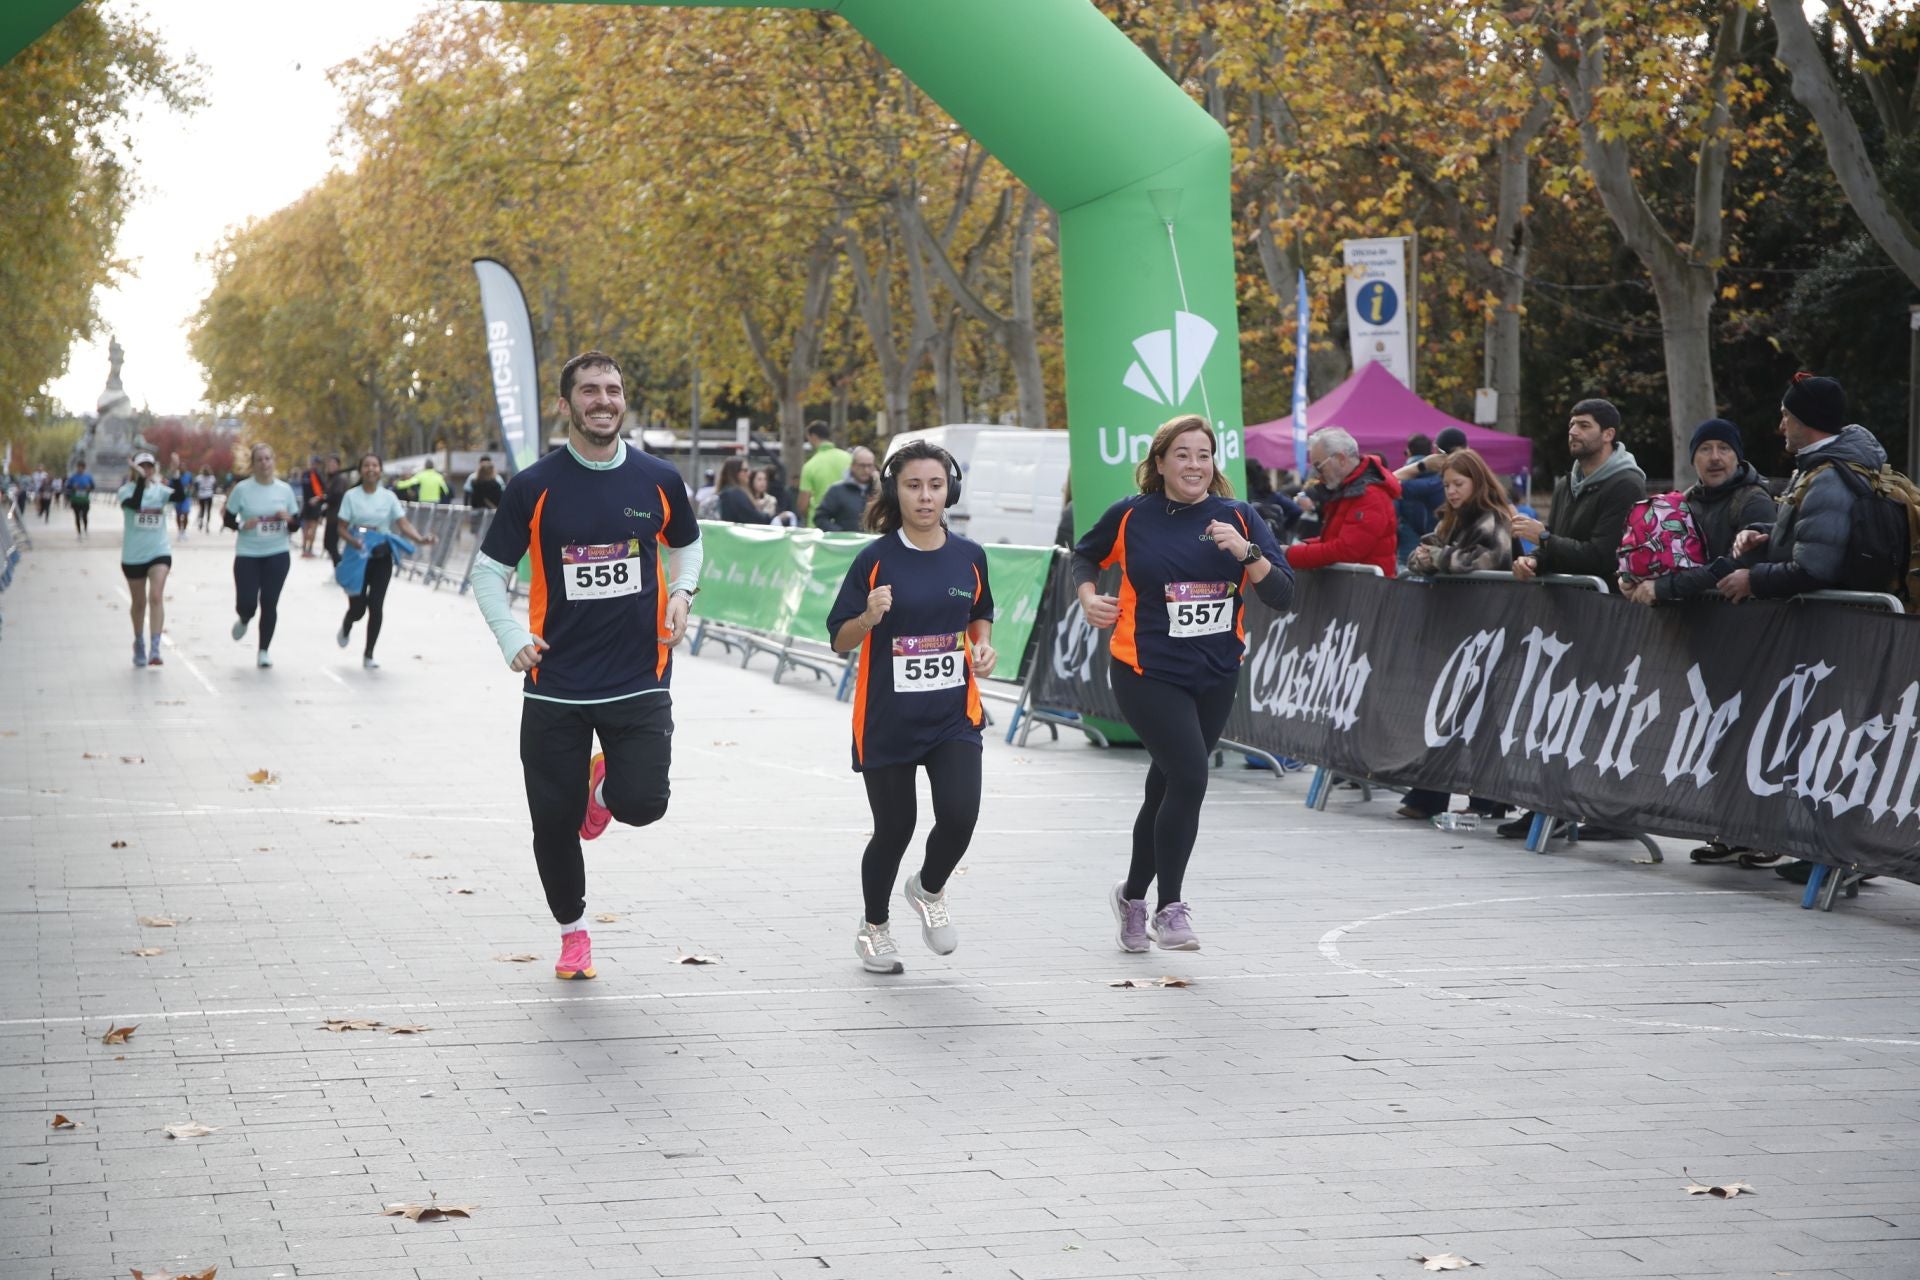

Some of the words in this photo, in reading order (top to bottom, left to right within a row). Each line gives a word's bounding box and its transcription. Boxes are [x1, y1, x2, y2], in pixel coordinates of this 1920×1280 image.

[1098, 420, 1240, 472] Unja
[576, 563, 629, 588] 558
[1177, 602, 1226, 626] 557
[904, 655, 955, 680] 559
[1424, 626, 1505, 747] El
[1500, 625, 1661, 780] Norte
[1661, 662, 1742, 788] de
[1746, 659, 1920, 830] Casti
